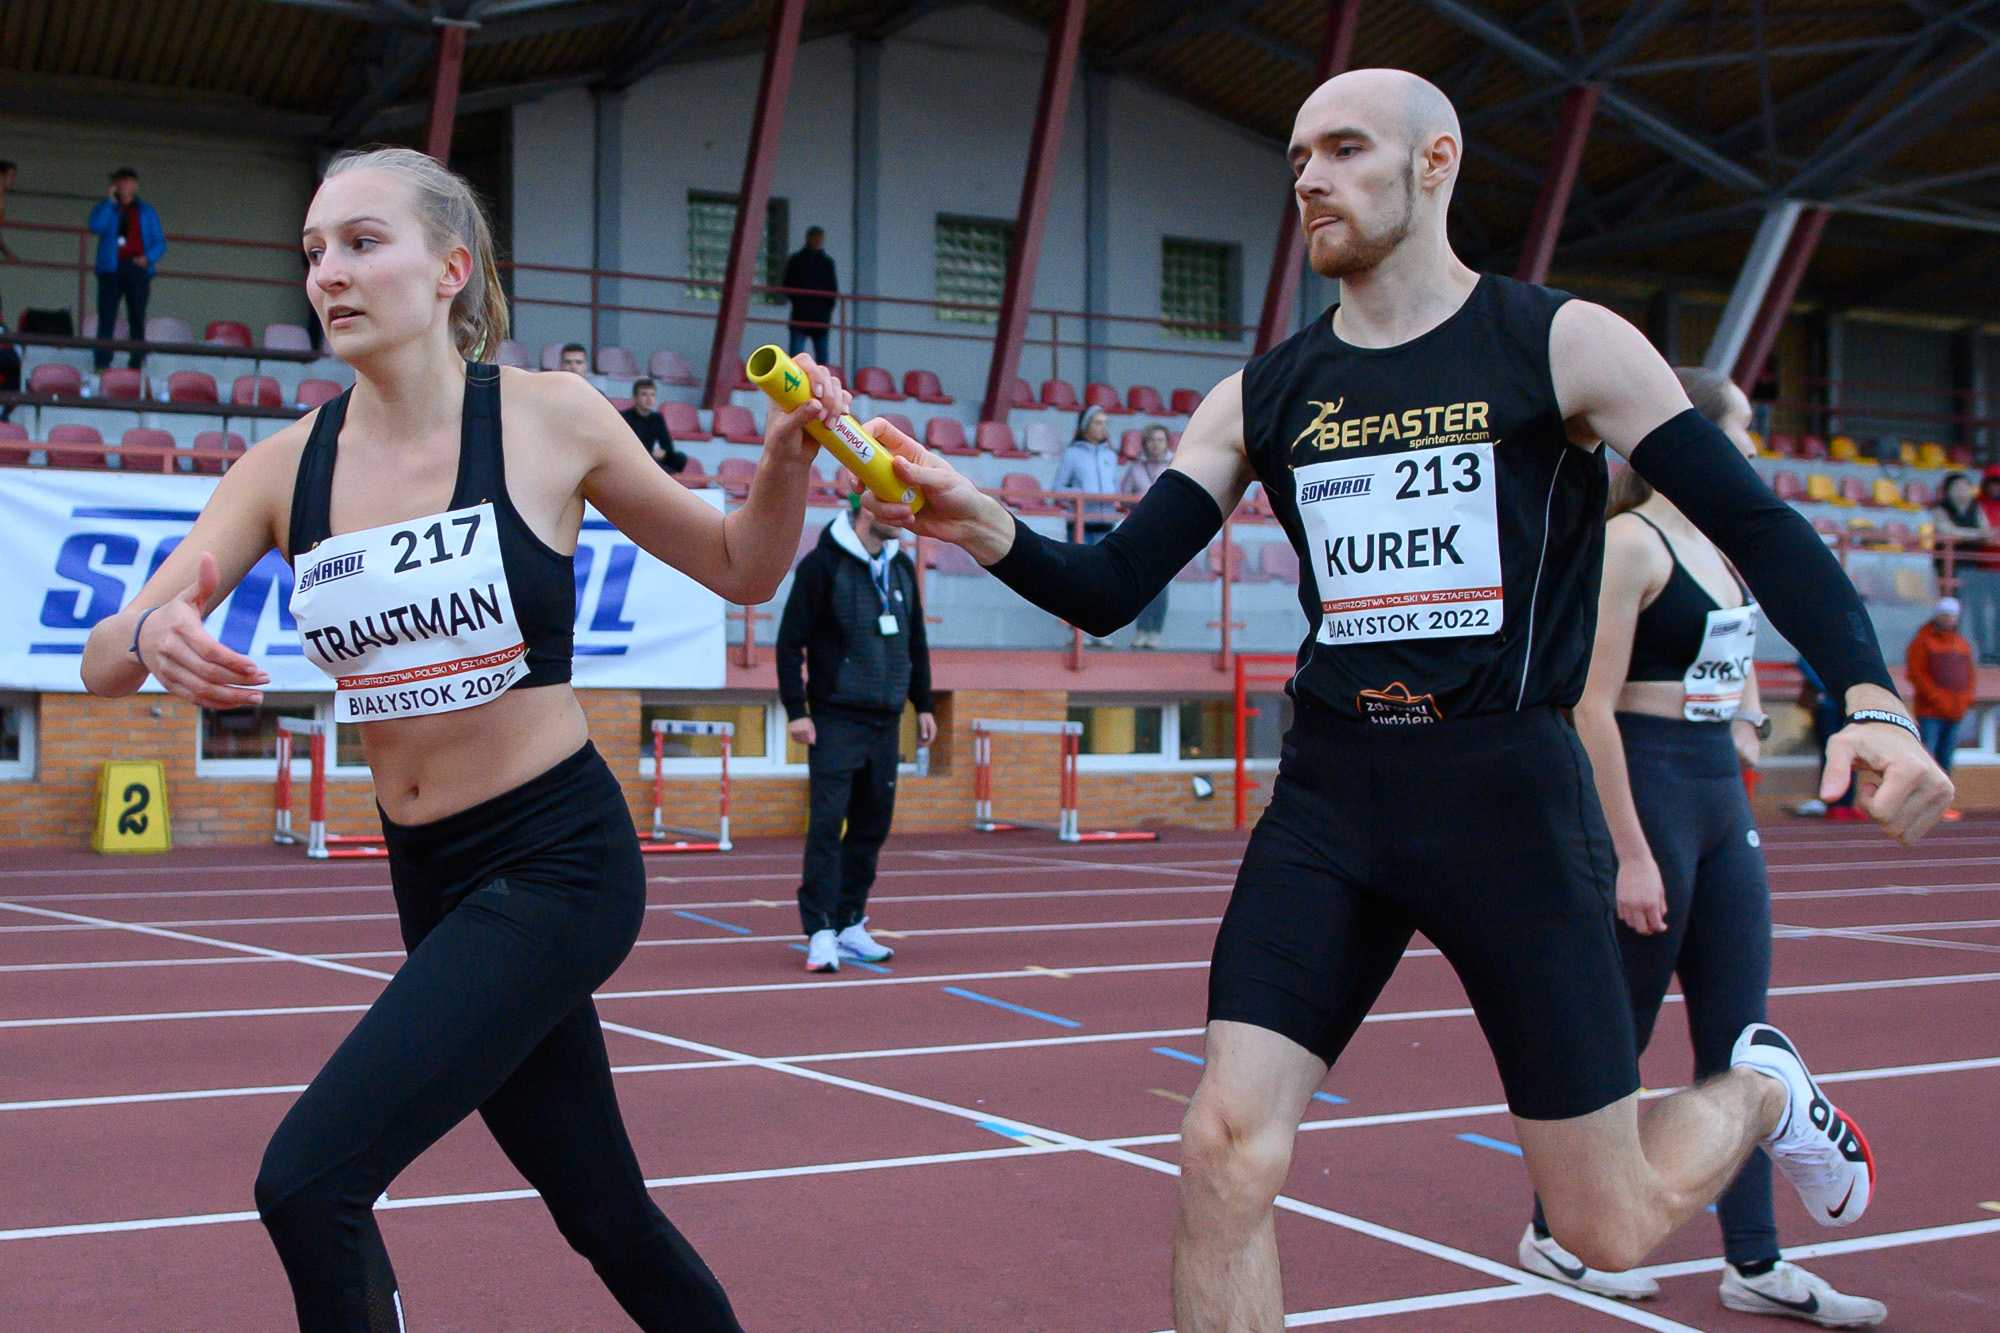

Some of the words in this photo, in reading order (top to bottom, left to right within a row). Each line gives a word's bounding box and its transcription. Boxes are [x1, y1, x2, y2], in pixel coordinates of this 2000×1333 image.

[784, 371, 801, 393] 4
[836, 421, 865, 449] polanik
[1319, 401, 1489, 451] BEFASTER
[1409, 432, 1490, 449] sprinterzy.com
[1301, 475, 1374, 503] SONAROL
[1395, 452, 1481, 500] 213
[390, 514, 481, 574] 217
[1324, 524, 1465, 578] KUREK
[1386, 594, 1418, 605] POLSKI
[1419, 593, 1431, 602] W
[1432, 589, 1497, 601] SZTAFETACH
[304, 583, 504, 663] TRAUTMAN
[1329, 612, 1420, 639] BIAŁYSTOK
[1428, 608, 1490, 630] 2022
[414, 665, 447, 679] POLSKI
[448, 662, 459, 672] W
[461, 647, 521, 670] SZTAFETACH
[349, 684, 457, 716] BIAŁYSTOK
[461, 665, 517, 700] 2022
[118, 782, 150, 835] 2
